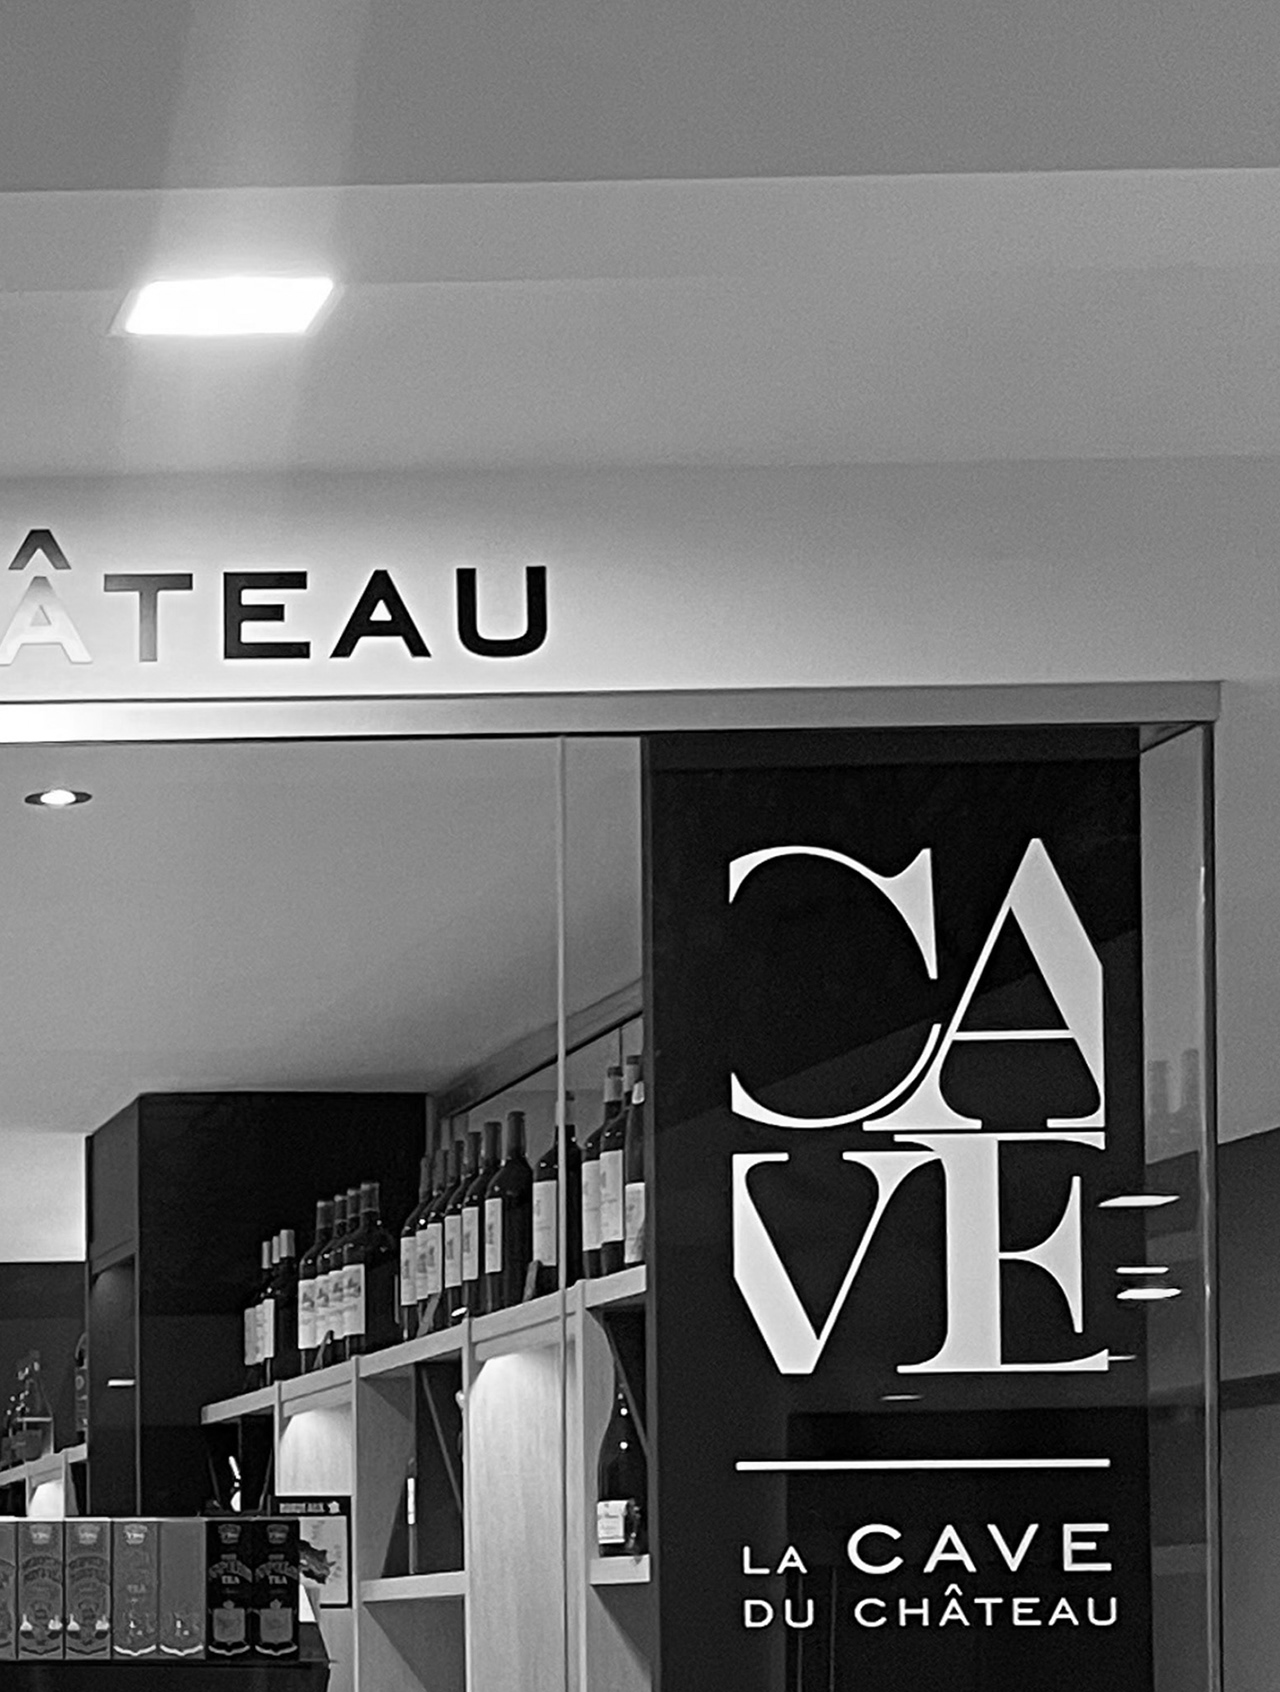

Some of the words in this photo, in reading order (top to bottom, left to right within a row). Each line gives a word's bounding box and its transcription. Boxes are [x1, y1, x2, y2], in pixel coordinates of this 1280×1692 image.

[743, 1545, 808, 1575] LA
[847, 1523, 1112, 1575] CAVE
[744, 1598, 814, 1629] DU
[854, 1583, 1118, 1628] CHÂTEAU
